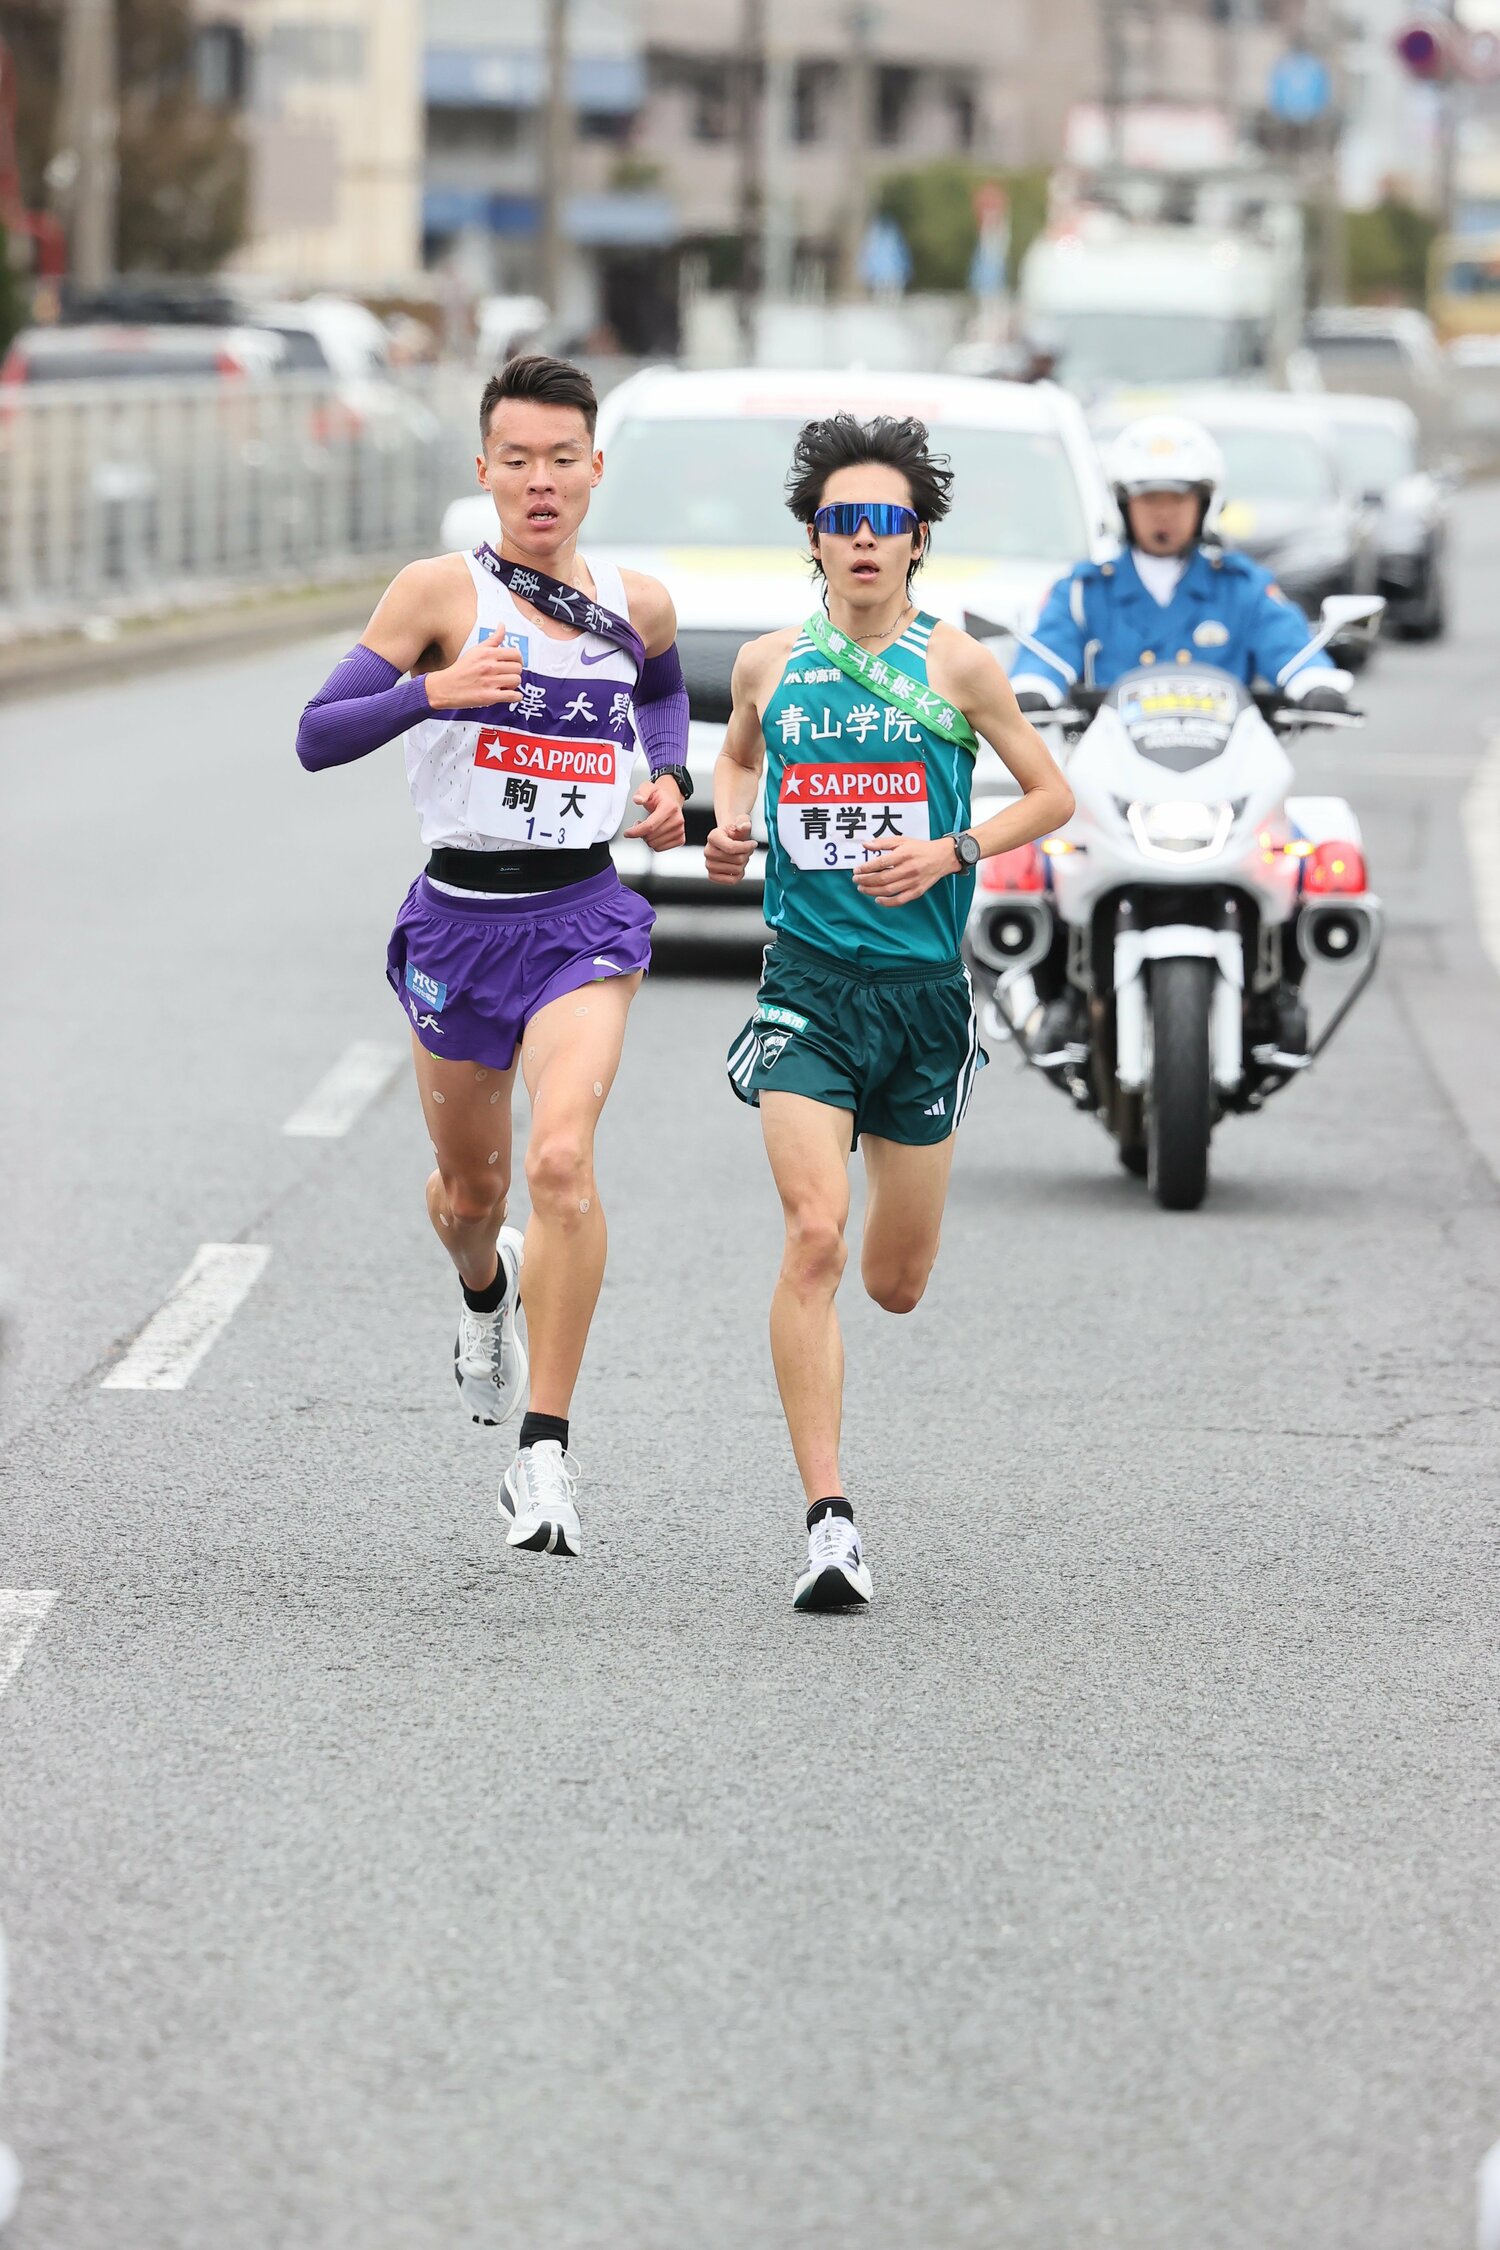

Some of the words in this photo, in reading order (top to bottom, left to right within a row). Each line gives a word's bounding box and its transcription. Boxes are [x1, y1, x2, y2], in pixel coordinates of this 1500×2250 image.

[804, 668, 841, 684] 妙高市
[775, 703, 922, 745] 青山学院
[513, 743, 613, 776] SAPPORO
[502, 777, 587, 819] 駒大
[809, 772, 921, 796] SAPPORO
[525, 816, 566, 845] 1-3
[800, 805, 903, 840] 青学大
